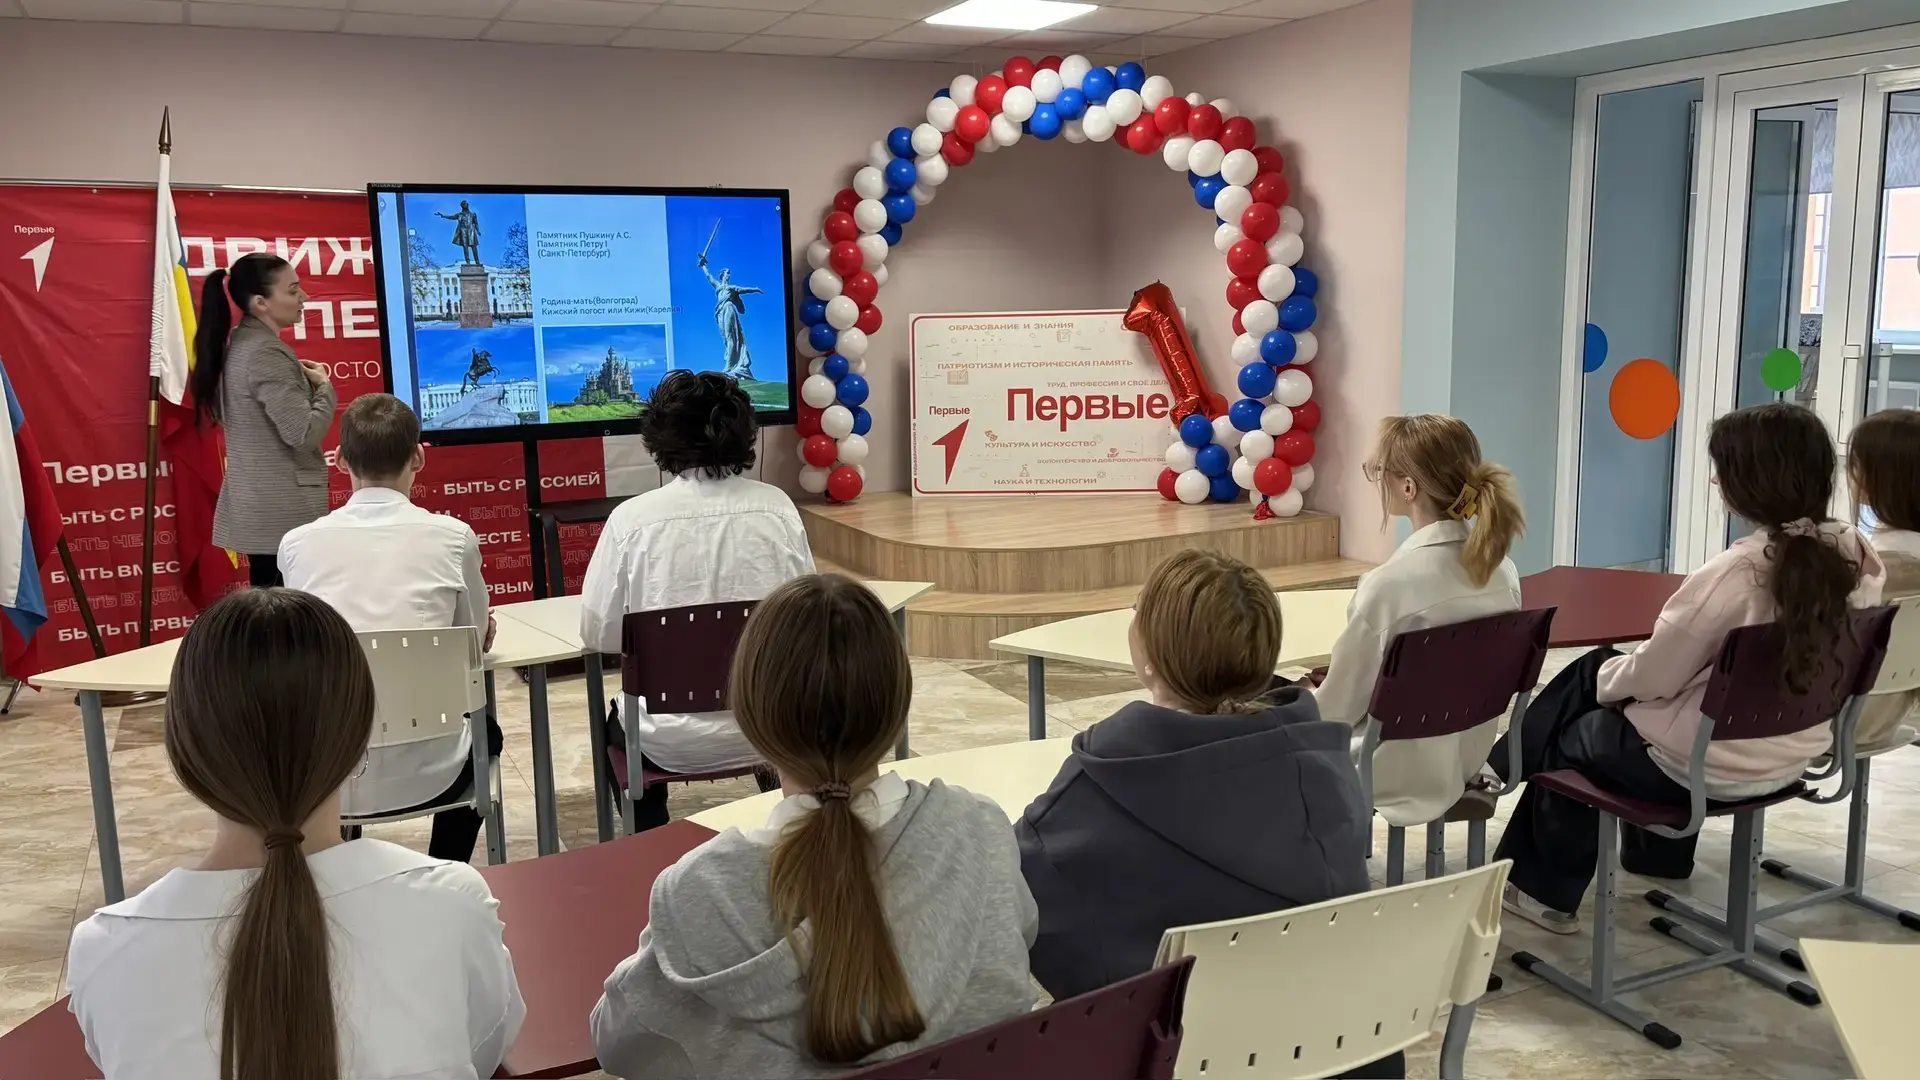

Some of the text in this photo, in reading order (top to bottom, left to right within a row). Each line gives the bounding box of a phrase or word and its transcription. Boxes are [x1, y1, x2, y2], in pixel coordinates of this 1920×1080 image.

[14, 225, 55, 236] Первые
[536, 231, 631, 240] Памятник Пушкину А.С.
[580, 240, 604, 249] Петру
[537, 248, 611, 259] (Санкт-Петербург)
[541, 296, 639, 306] Родина-мать(Волгоград)
[541, 307, 578, 315] Кижский
[580, 307, 606, 315] погост
[624, 305, 684, 314] Кижи(Карелия)
[948, 323, 1020, 332] ОБРАЗОВАНИЕ
[1034, 322, 1074, 330] ЗНАНИЯ
[937, 359, 1133, 370] ПАТРИОТИЗМ И ИСТОРИЧЕСКАЯ ПАМЯТЬ
[1047, 381, 1069, 389] ТРУД,
[1070, 380, 1119, 388] ПРОФЕССИЯ
[929, 405, 971, 417] Первые
[1007, 388, 1169, 432] Первые
[1040, 440, 1097, 448] ИСКУССТВО
[42, 460, 173, 487] Первы
[444, 480, 495, 496] БЫТЬ
[498, 478, 512, 492] С
[515, 471, 601, 492] РССИЕЙ
[110, 507, 125, 522] С
[51, 537, 110, 554] ЫТЬ
